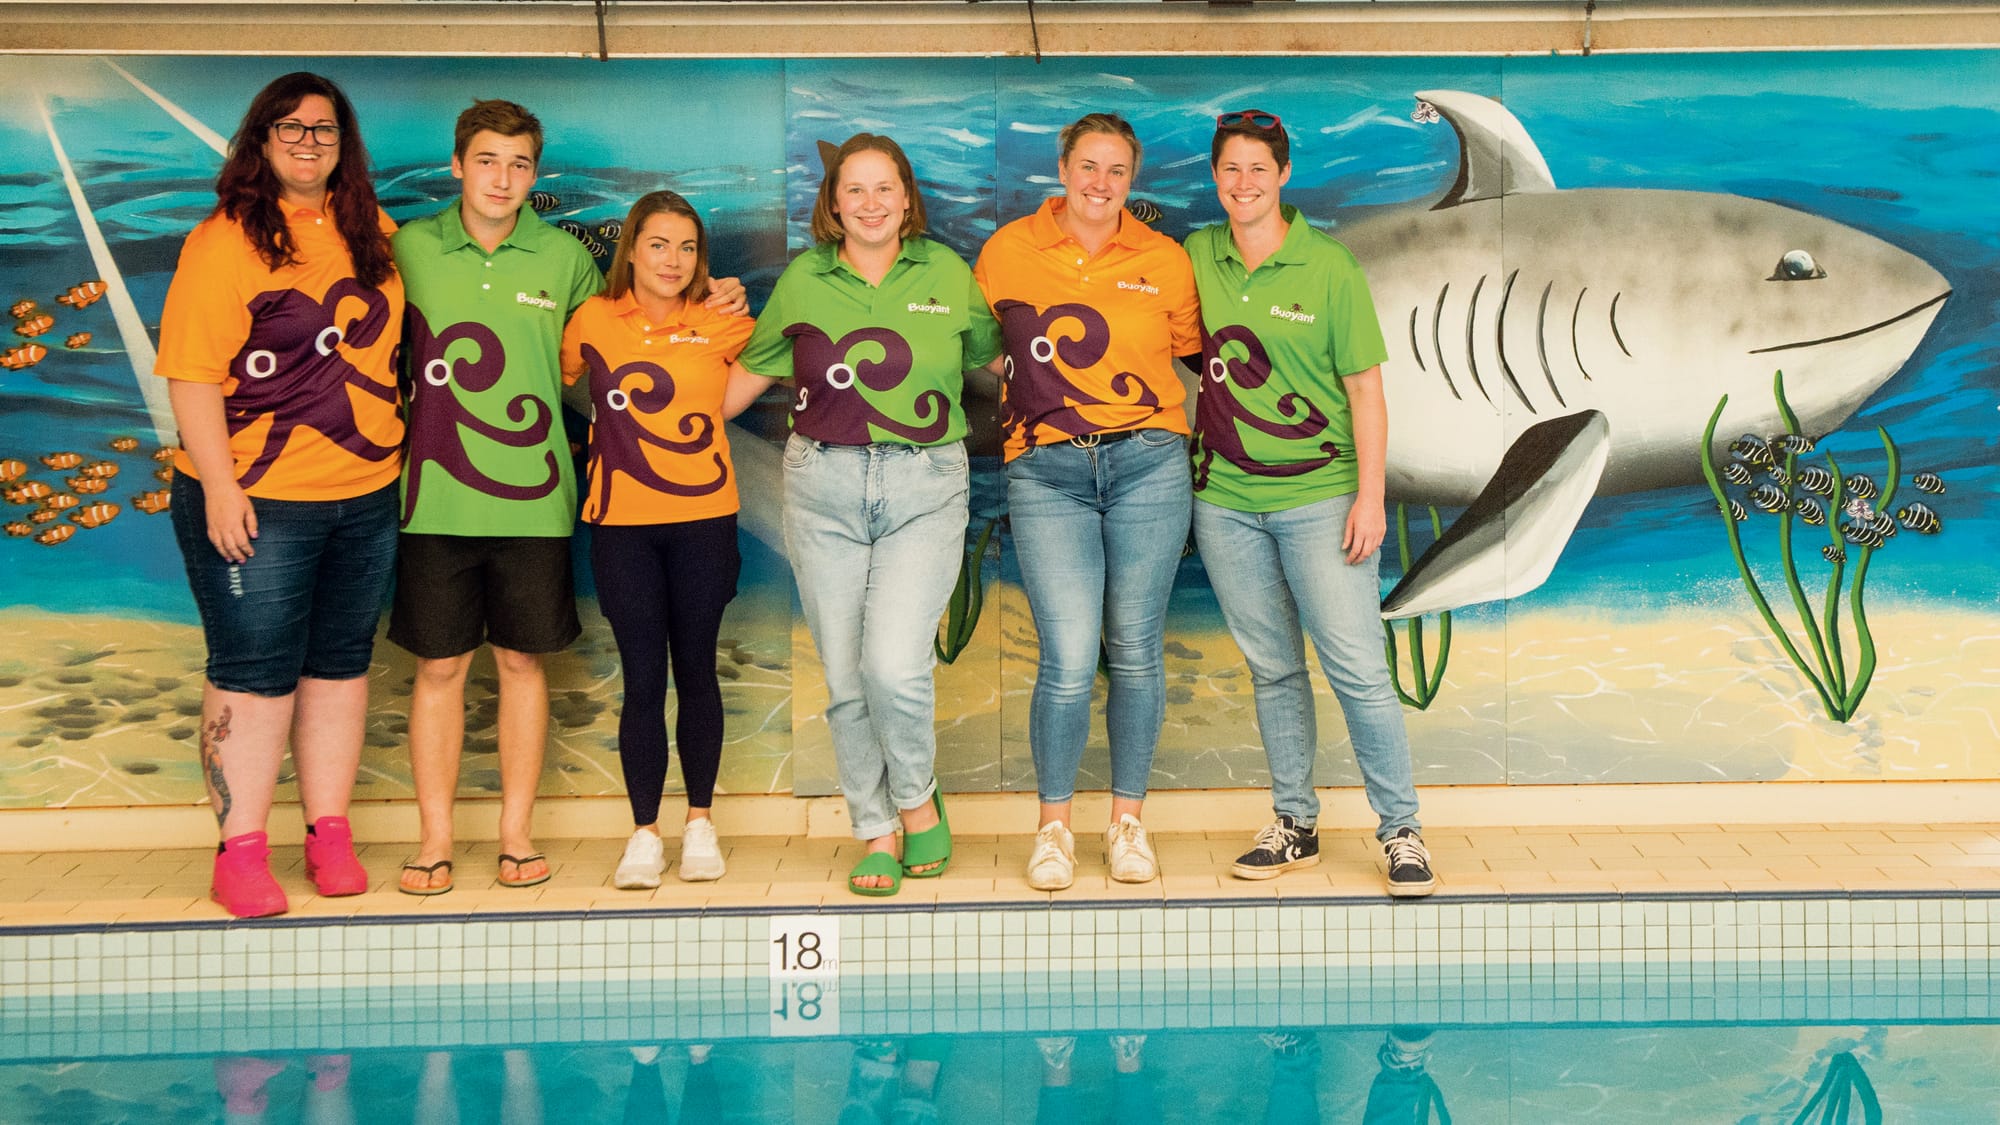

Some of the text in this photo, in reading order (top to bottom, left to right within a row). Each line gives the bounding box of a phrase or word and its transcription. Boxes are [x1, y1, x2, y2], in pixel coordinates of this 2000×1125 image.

[1117, 281, 1159, 295] Buoyant
[908, 303, 950, 314] Buoyant
[1270, 305, 1315, 323] Buoyant
